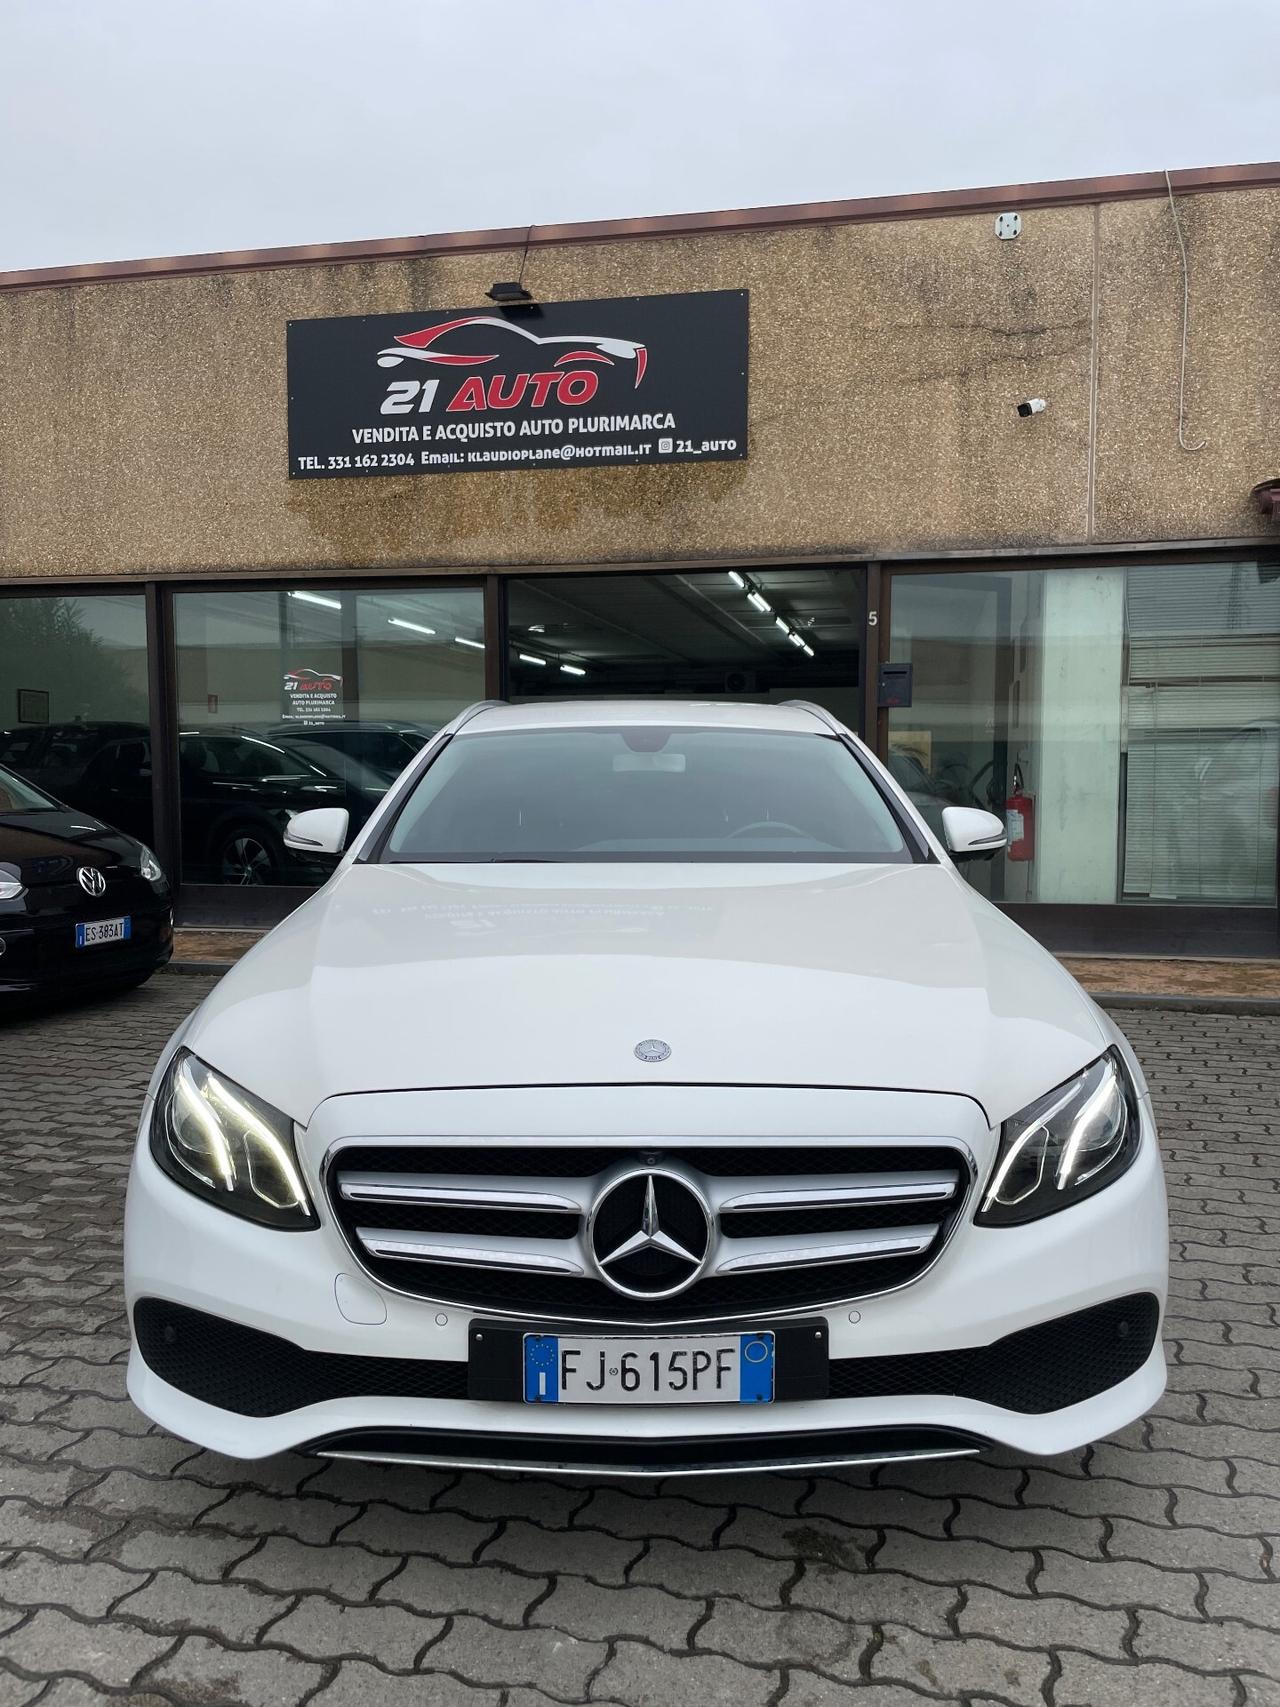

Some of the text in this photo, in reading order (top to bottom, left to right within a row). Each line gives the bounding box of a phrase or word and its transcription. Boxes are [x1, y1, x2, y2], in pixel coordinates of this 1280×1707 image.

[380, 370, 598, 415] 21 AUTO
[352, 413, 676, 444] VENDITA E ACQUISTO AUTO PLURIMARCA
[298, 456, 325, 470] TEL.
[328, 455, 351, 469] 331
[355, 454, 378, 467] 162
[381, 452, 414, 467] 2304
[868, 611, 878, 626] 5
[284, 680, 332, 690] 21 AUTO
